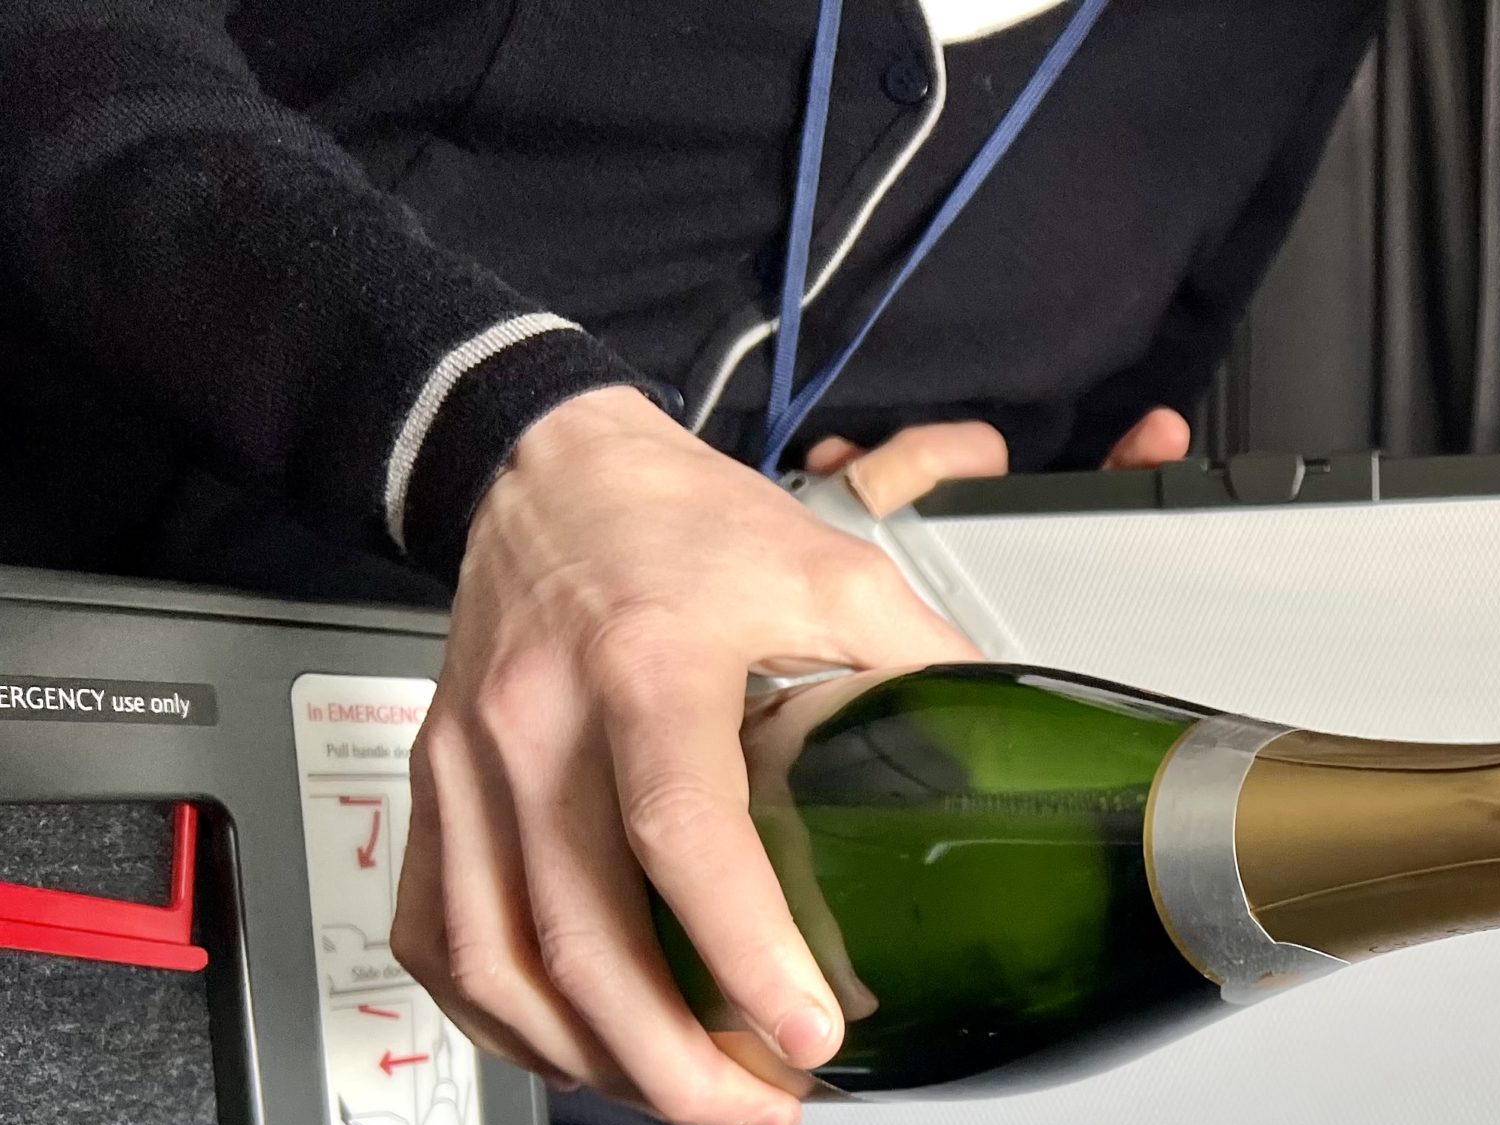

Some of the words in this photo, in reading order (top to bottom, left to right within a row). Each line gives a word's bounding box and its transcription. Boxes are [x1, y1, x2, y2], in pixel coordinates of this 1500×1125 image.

[112, 695, 145, 713] use
[150, 692, 190, 719] only
[307, 702, 323, 721] In
[328, 702, 427, 725] EMERGENC
